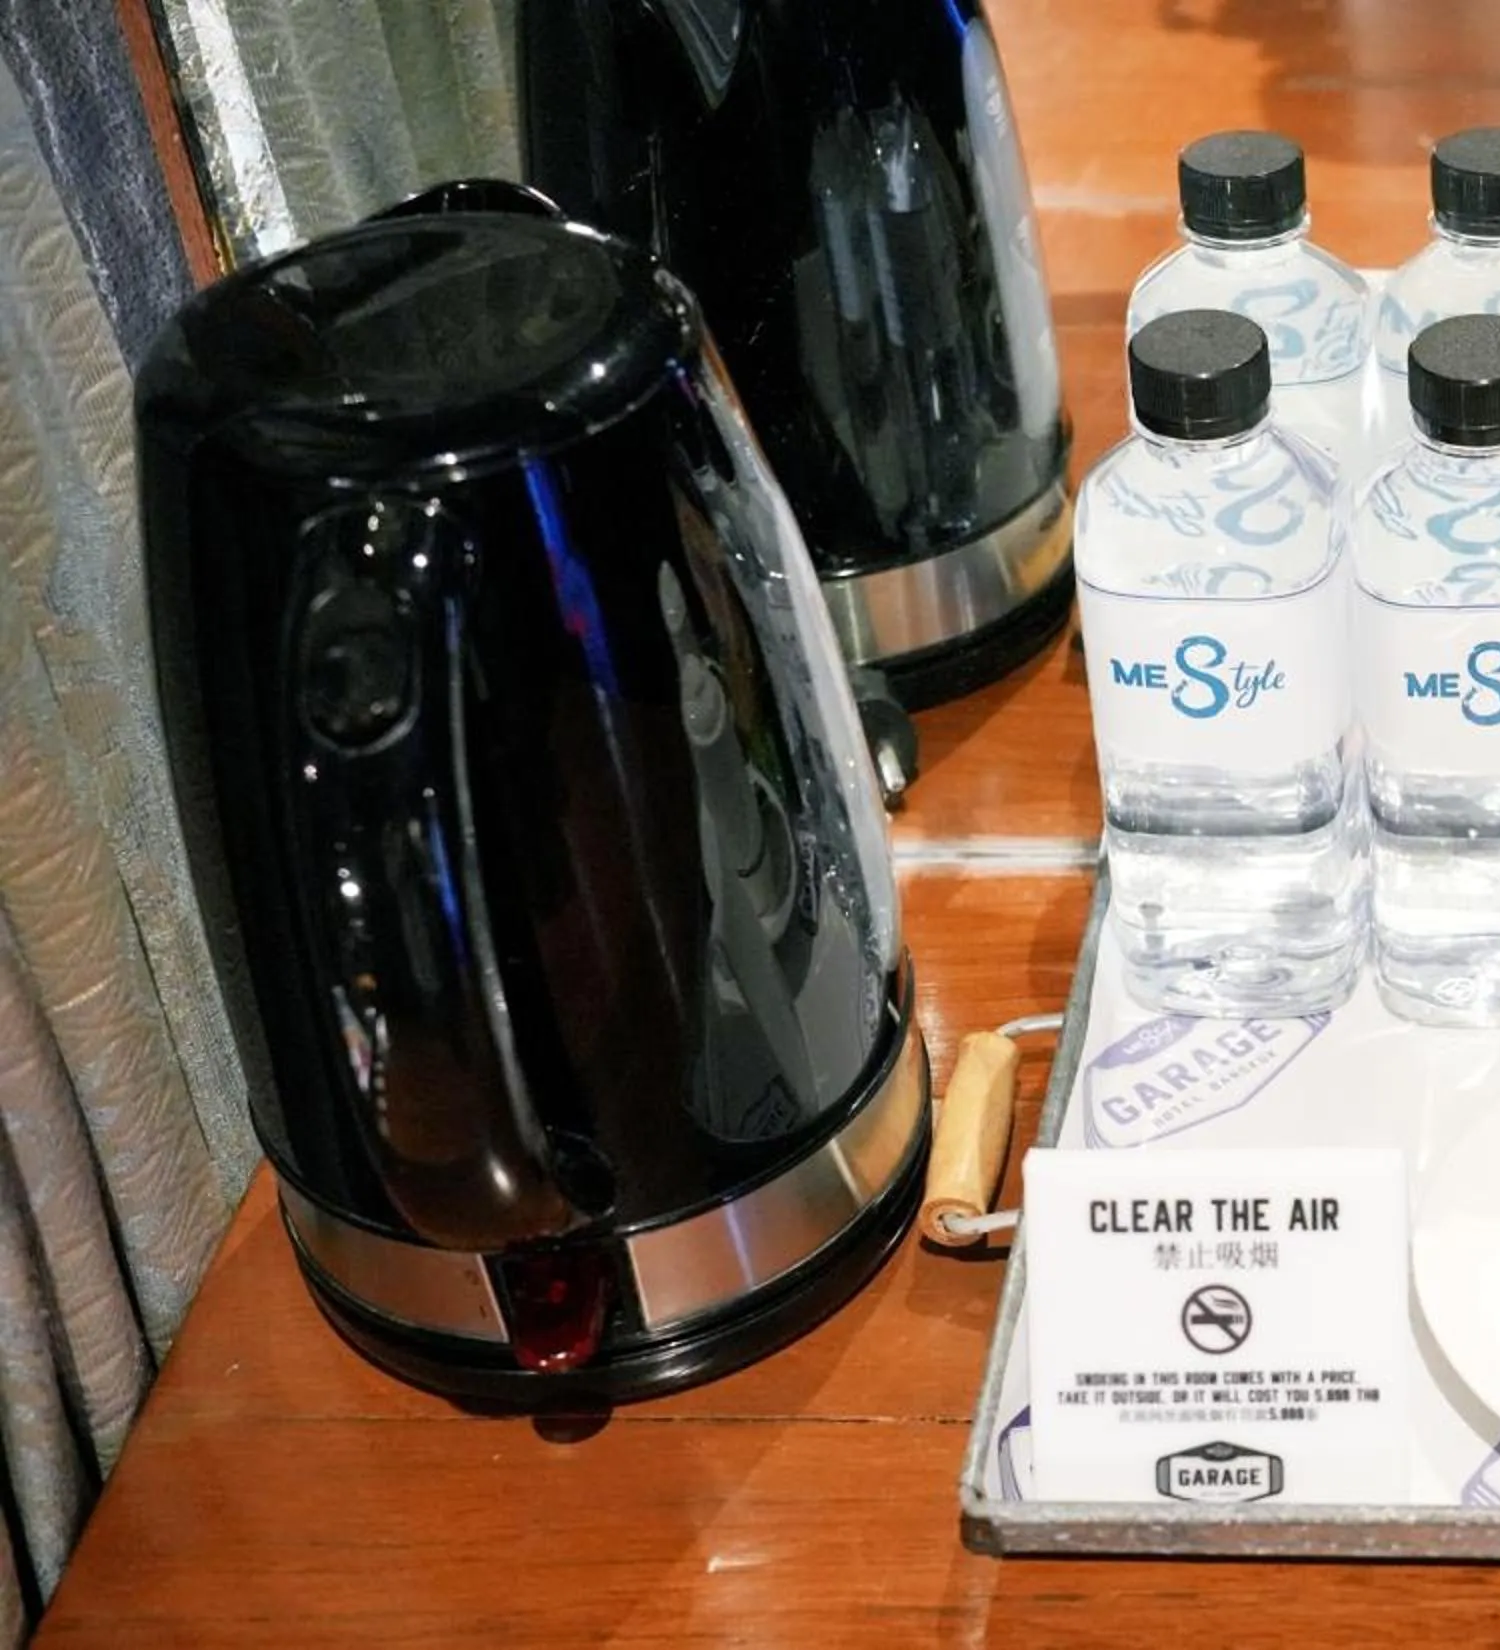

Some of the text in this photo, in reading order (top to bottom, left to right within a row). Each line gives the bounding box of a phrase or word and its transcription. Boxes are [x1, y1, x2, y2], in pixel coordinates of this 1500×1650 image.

[1110, 658, 1168, 689] ME
[1404, 672, 1460, 699] ME
[1101, 1018, 1282, 1125] GARAGE
[1090, 1198, 1340, 1234] CLEAR THE AIR
[1153, 1241, 1280, 1270] 禁止吸烟
[1075, 1372, 1129, 1387] SMOKING
[1133, 1372, 1147, 1386] IN
[1153, 1372, 1179, 1386] THIS
[1185, 1372, 1218, 1385] ROOM
[1223, 1371, 1265, 1384] COMES
[1271, 1371, 1301, 1384] WITH
[1307, 1371, 1316, 1384] A
[1057, 1391, 1088, 1405] TAKE
[1095, 1390, 1106, 1404] IT
[1173, 1390, 1189, 1403] OR
[1195, 1390, 1206, 1403] IT
[1212, 1389, 1242, 1403] WILL
[1249, 1389, 1279, 1402] COST
[1286, 1389, 1310, 1402] YOU
[1357, 1388, 1381, 1402] THB
[1178, 1468, 1263, 1487] GARAGE
